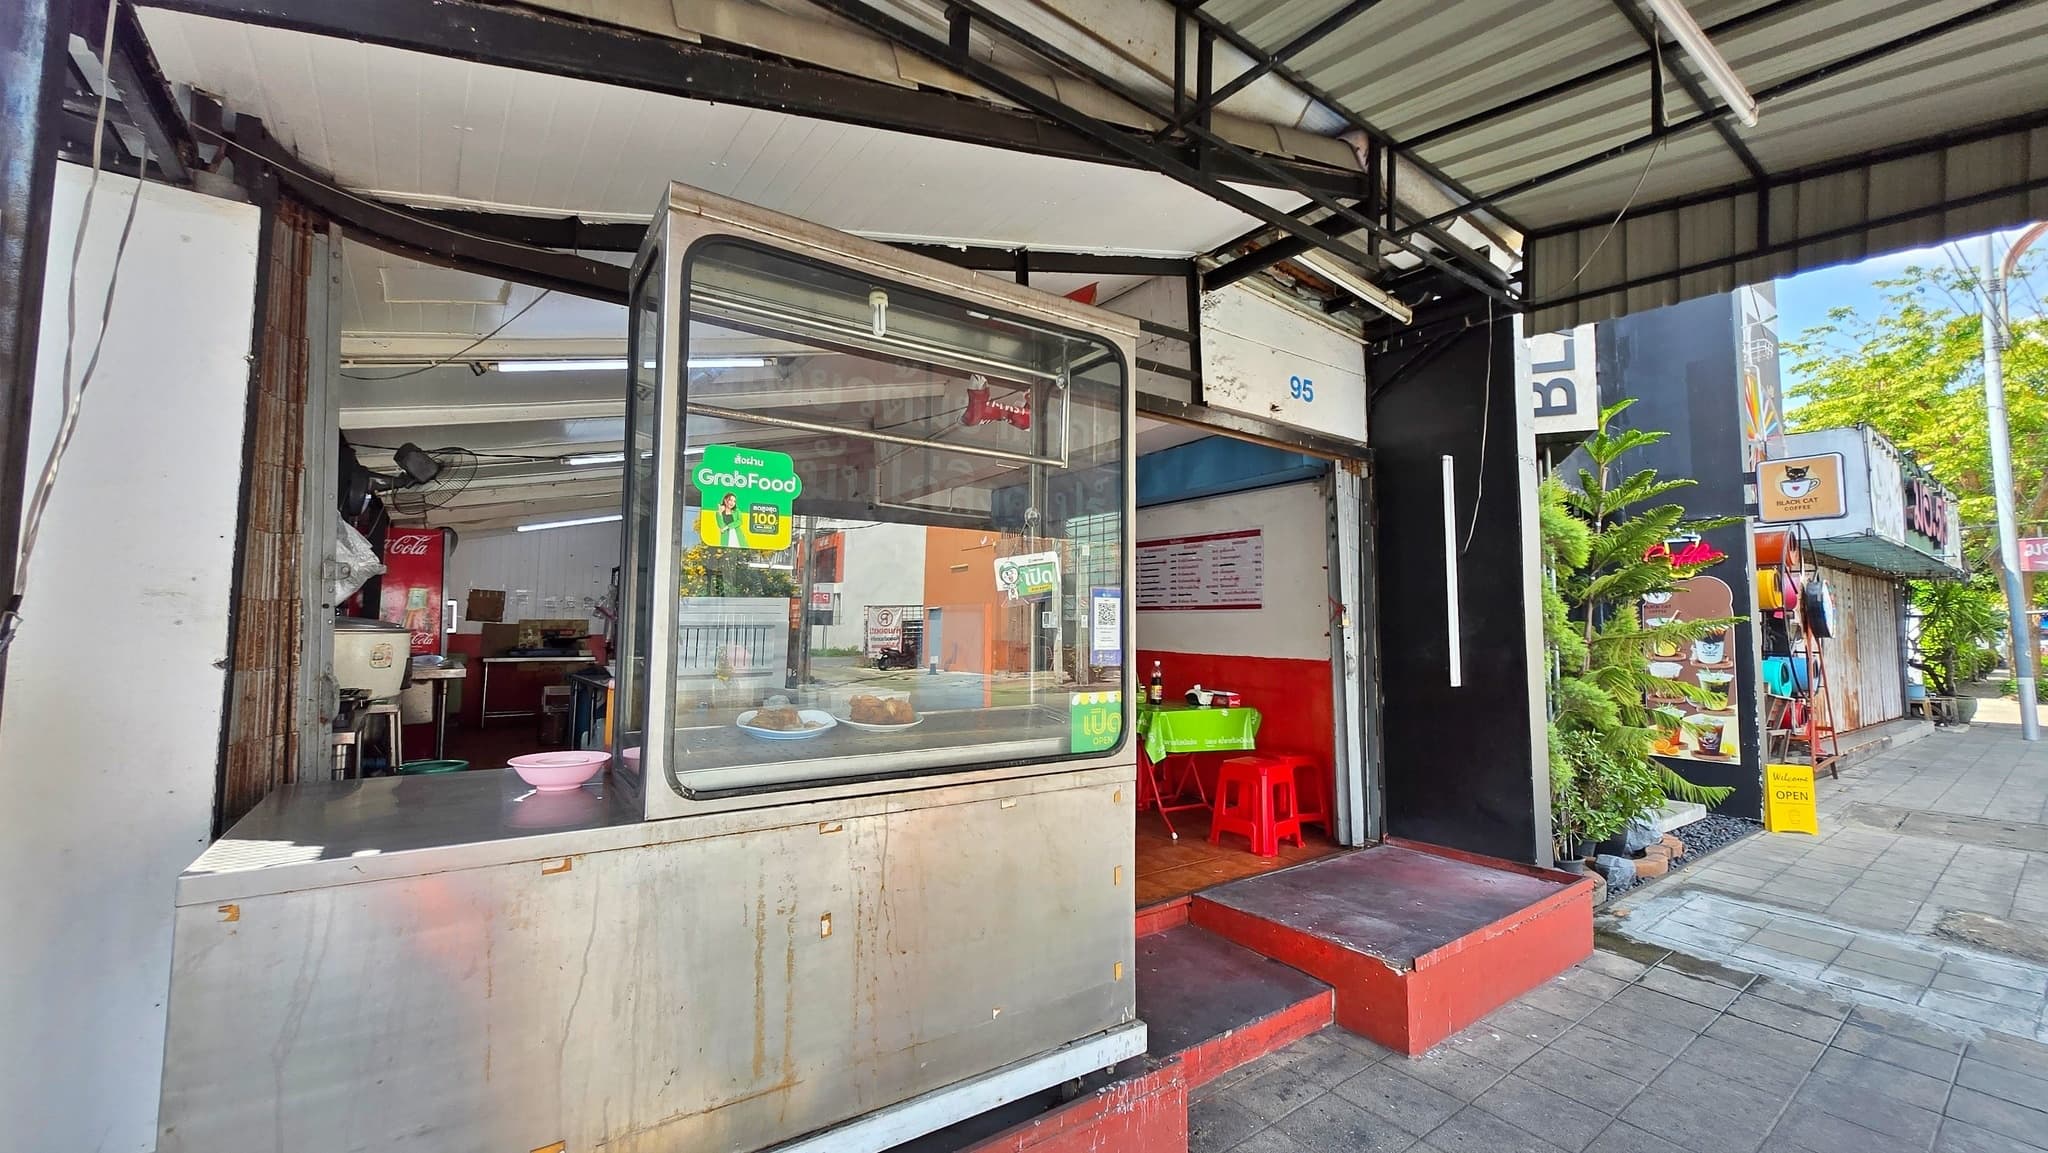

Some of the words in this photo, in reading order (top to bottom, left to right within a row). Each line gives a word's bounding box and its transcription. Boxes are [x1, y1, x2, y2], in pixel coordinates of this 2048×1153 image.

[1290, 376, 1314, 402] 95
[734, 453, 764, 467] สั่งผ่าน
[698, 468, 796, 493] GrabFood
[1773, 772, 1809, 782] Welcome
[1776, 790, 1809, 801] OPEN
